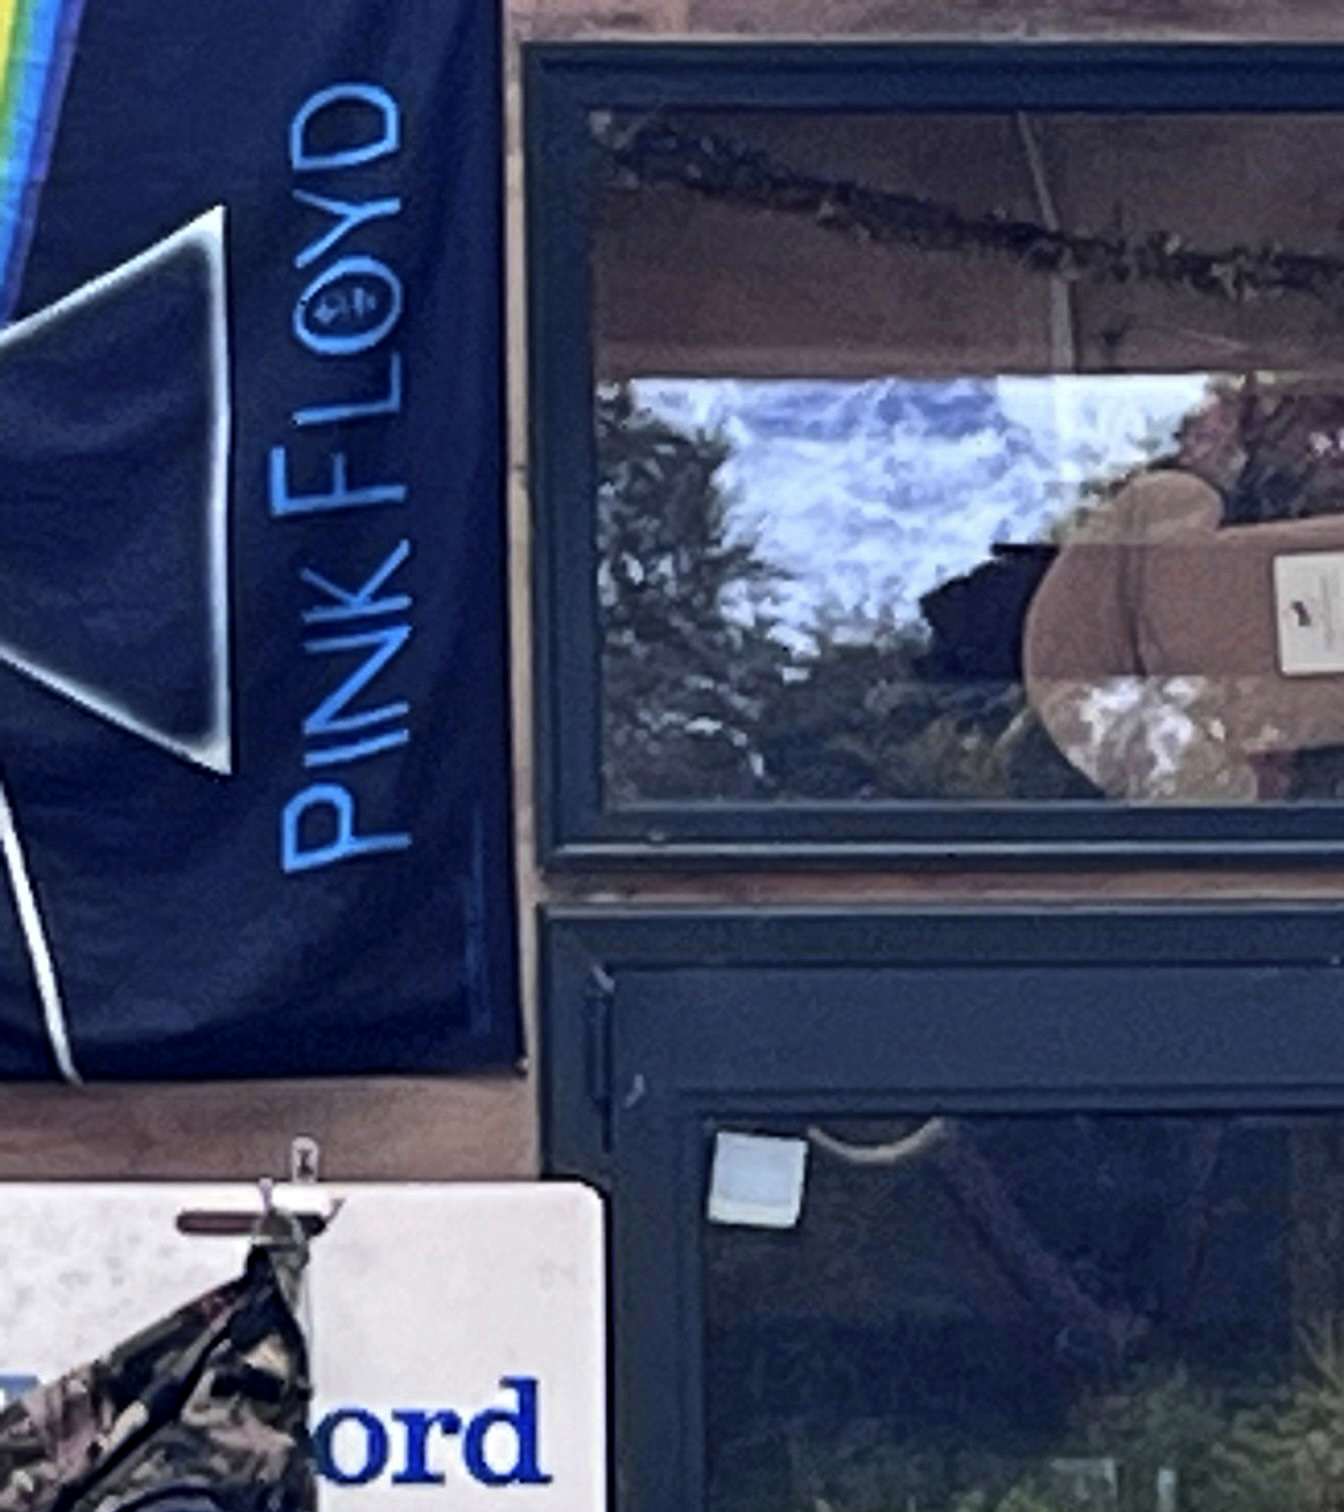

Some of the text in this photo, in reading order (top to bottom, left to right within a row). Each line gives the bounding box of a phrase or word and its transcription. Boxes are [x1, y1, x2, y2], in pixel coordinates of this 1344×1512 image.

[269, 82, 412, 874] PINK FLOYD
[312, 1375, 553, 1487] ord
